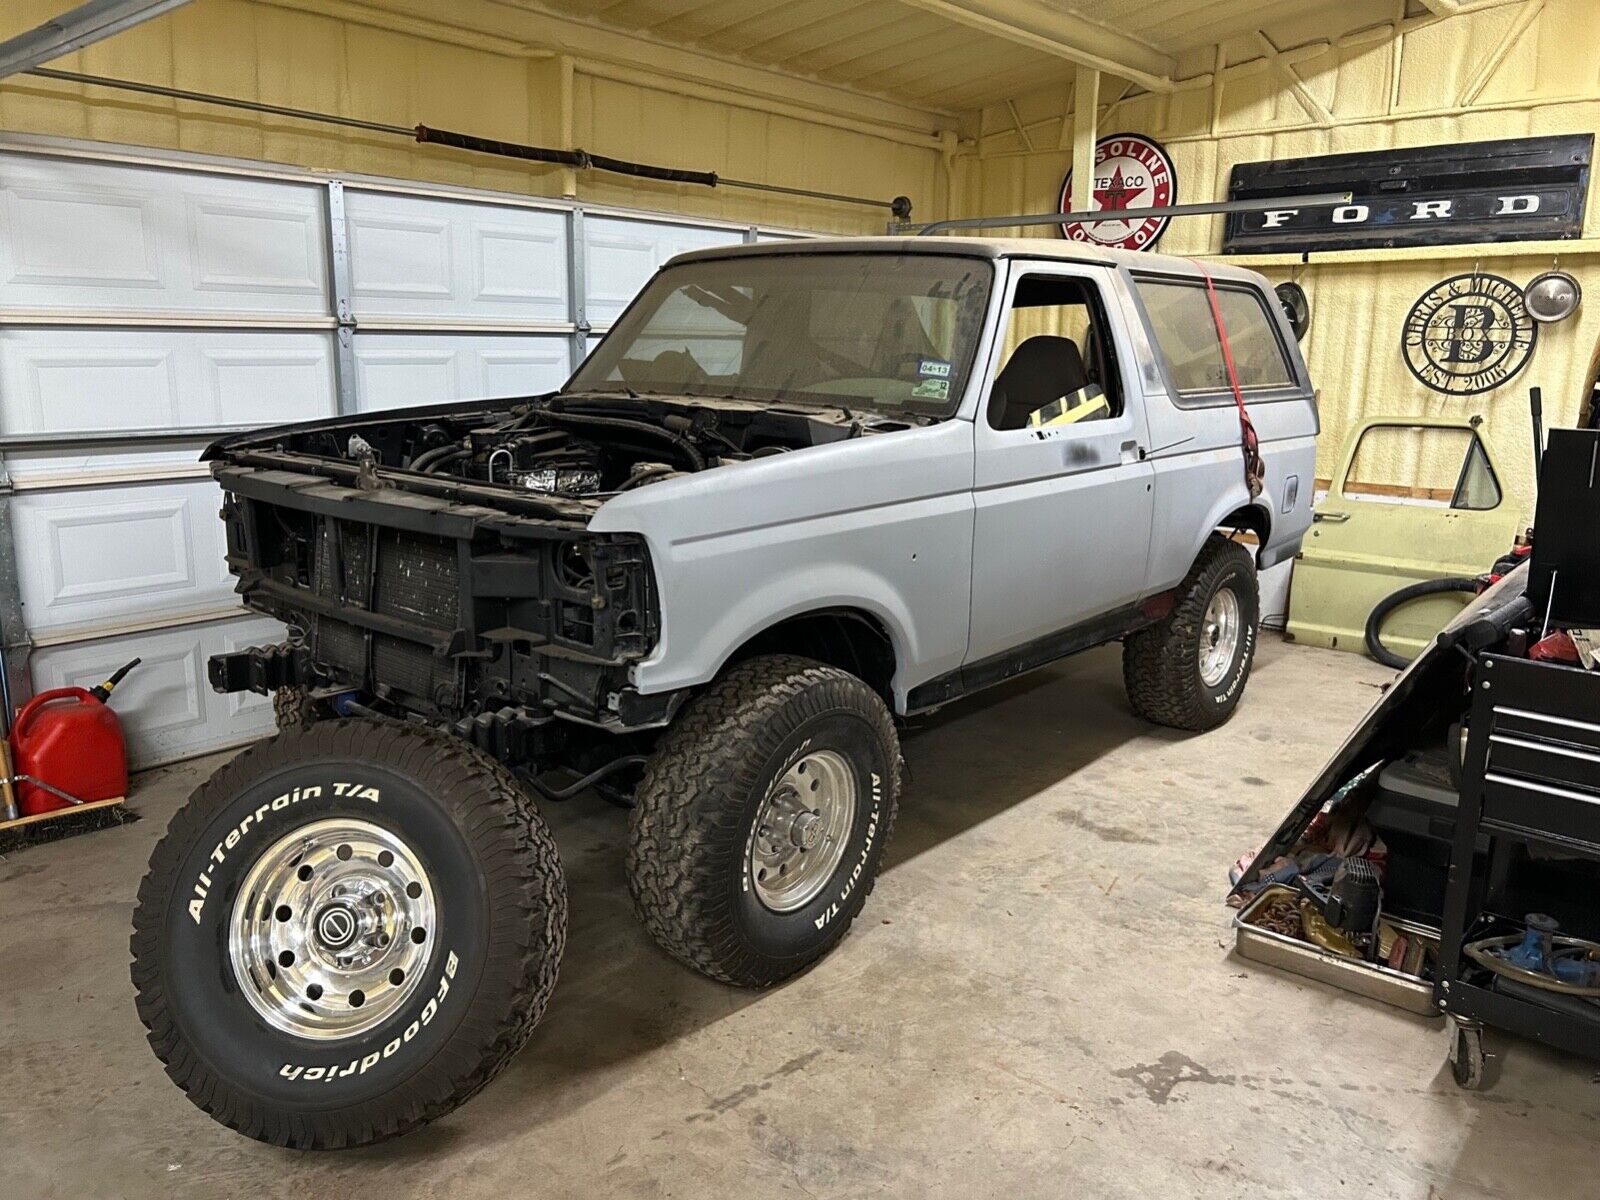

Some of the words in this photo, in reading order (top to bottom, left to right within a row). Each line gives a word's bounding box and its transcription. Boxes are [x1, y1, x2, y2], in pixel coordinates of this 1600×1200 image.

[1094, 176, 1144, 189] TEXACO
[1095, 142, 1168, 187] SOLINE
[1262, 194, 1540, 229] FORD
[1406, 291, 1443, 346] CHRIS
[1448, 283, 1462, 296] &
[1469, 277, 1533, 351] MICHELLE
[1464, 365, 1507, 390] 2006
[1227, 624, 1252, 696] All-Terrain
[188, 785, 322, 925] All-Terrain
[333, 783, 380, 803] T/A
[840, 772, 881, 900] All-Terrain
[814, 902, 839, 930] T/A
[279, 950, 459, 1083] BFGoodrich
